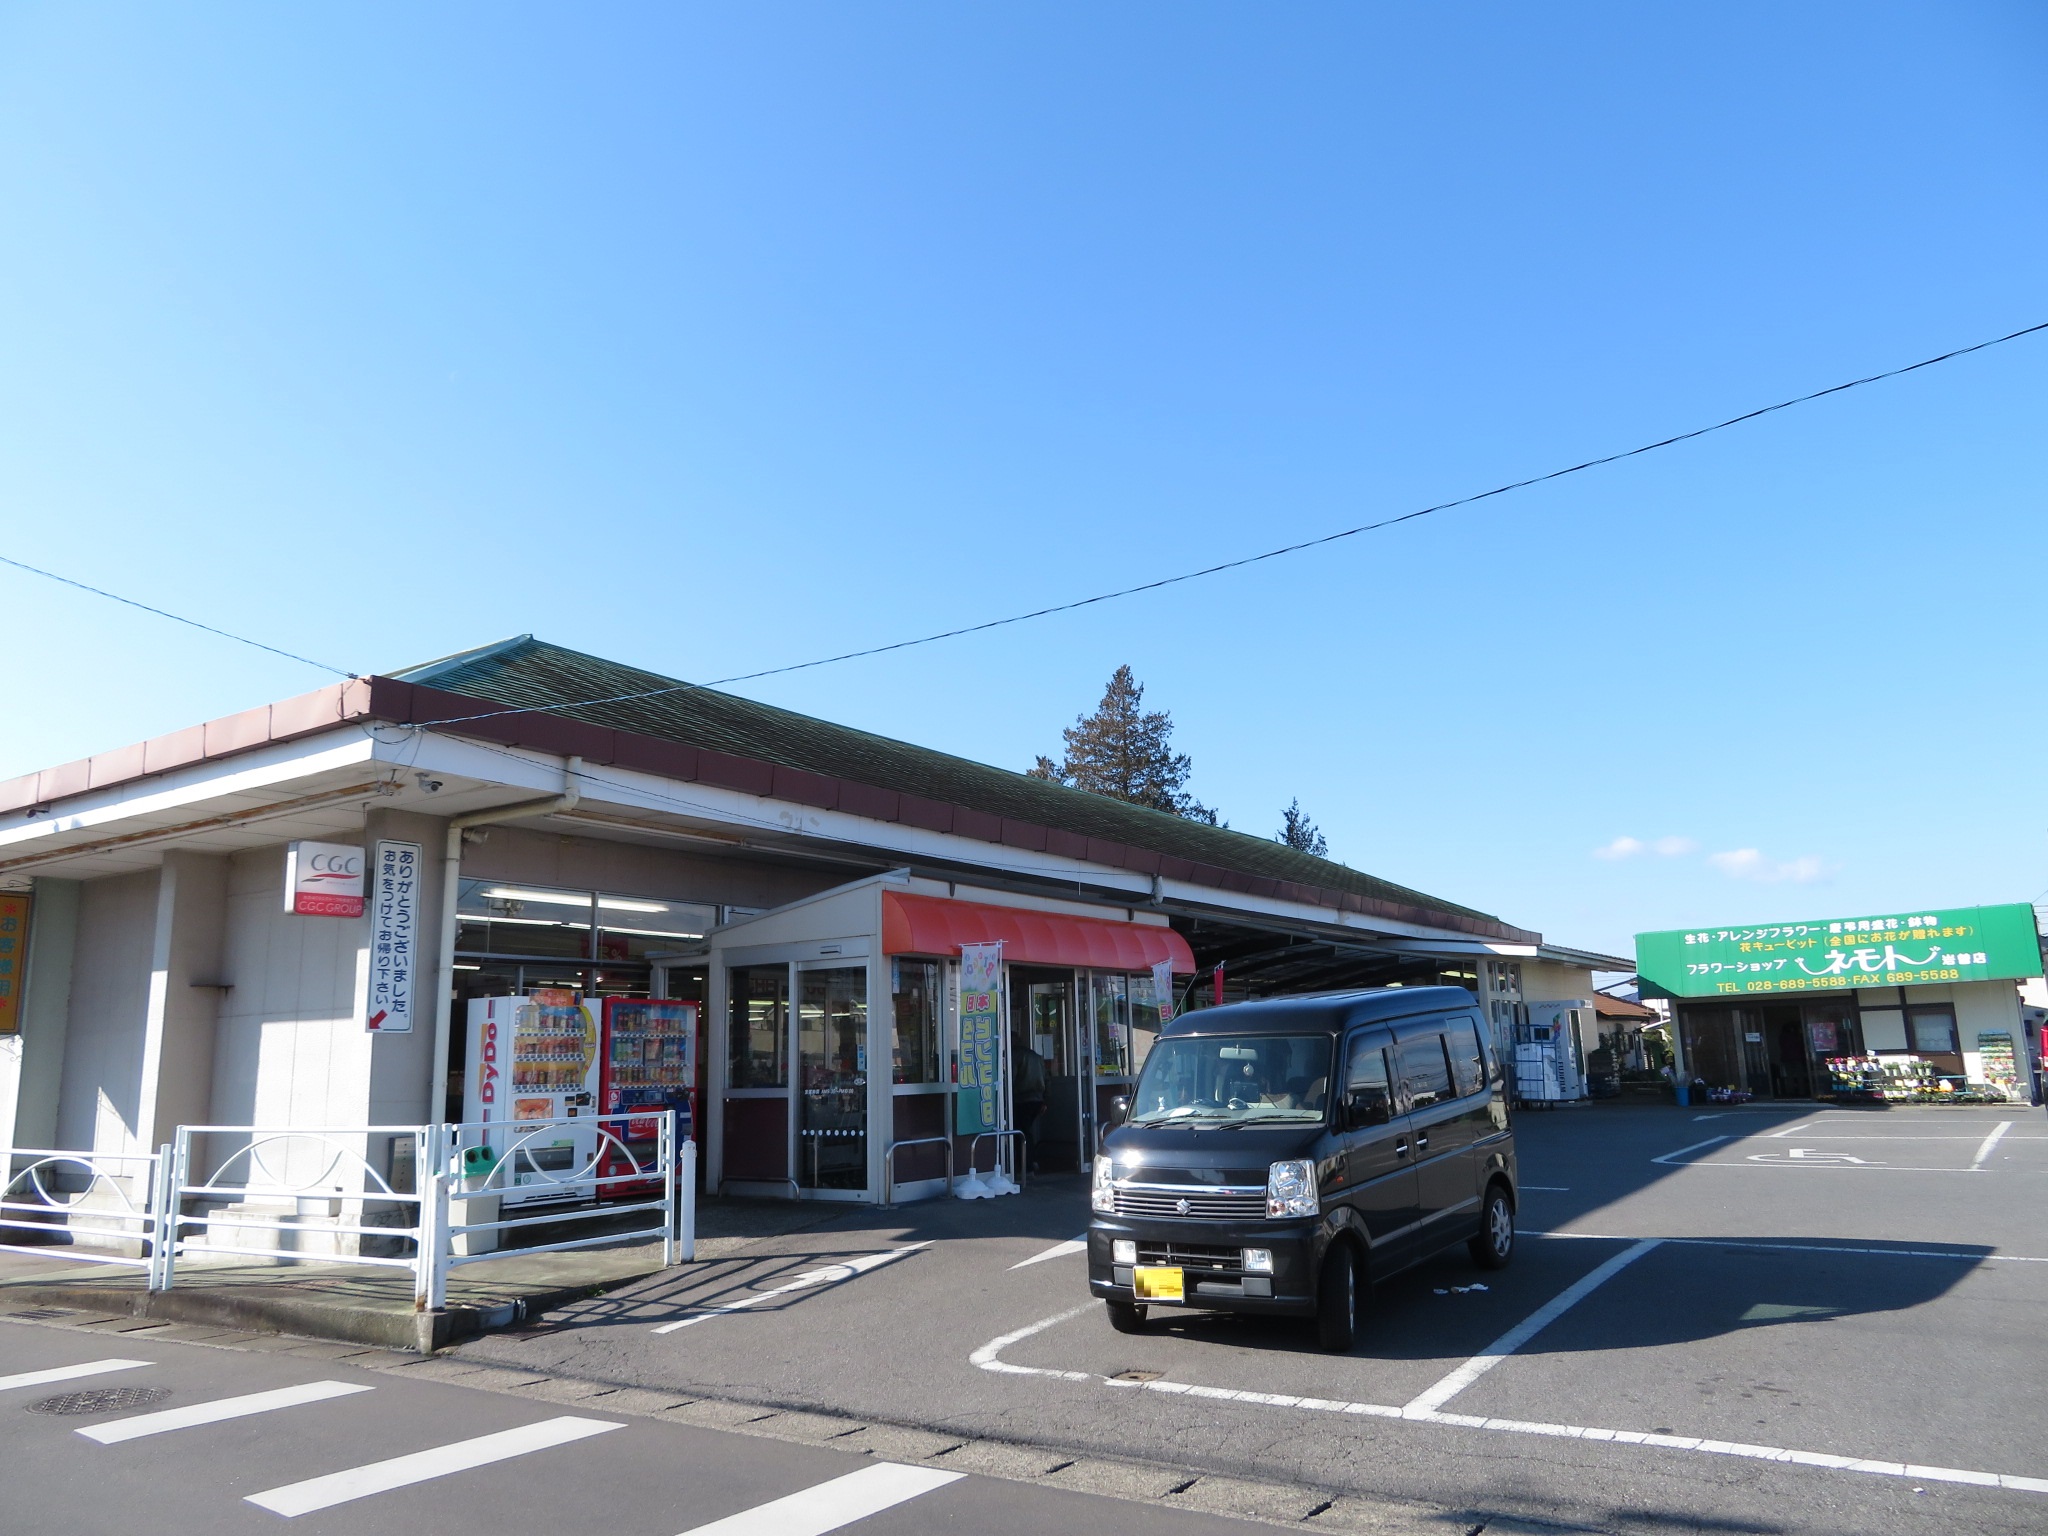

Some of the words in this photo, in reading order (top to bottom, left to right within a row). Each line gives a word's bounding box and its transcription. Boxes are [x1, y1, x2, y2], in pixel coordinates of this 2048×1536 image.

[311, 853, 359, 874] CGC
[298, 900, 324, 912] CGC
[326, 902, 362, 914] GROUP
[376, 850, 396, 1005] お気をつけてお帰り下さい
[391, 850, 414, 1018] ありがとうございました。
[1686, 958, 1788, 976] フラワーショップ
[1805, 944, 1922, 976] ネモト
[1716, 982, 1740, 993] TEL
[1886, 969, 1959, 983] 689-5588
